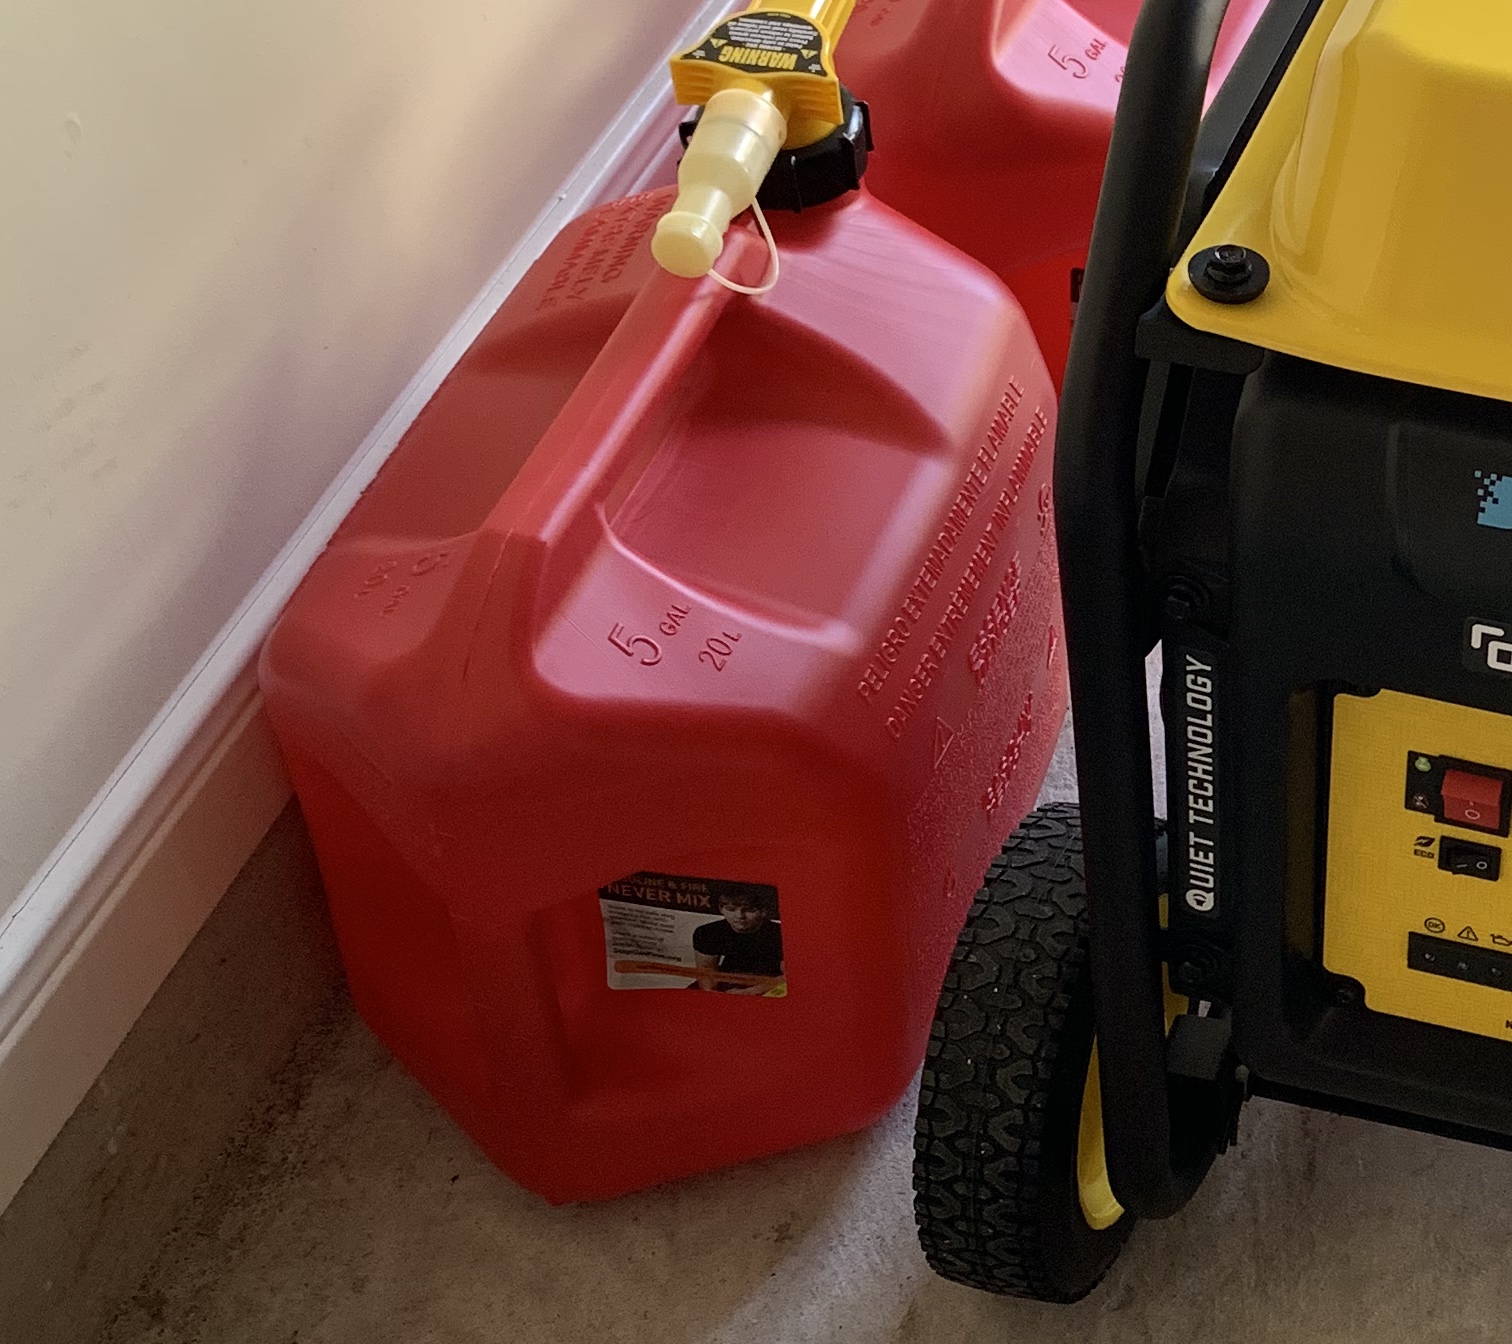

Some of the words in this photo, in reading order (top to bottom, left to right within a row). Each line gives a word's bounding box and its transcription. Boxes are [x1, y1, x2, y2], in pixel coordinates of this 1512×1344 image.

[719, 46, 798, 70] WARNING
[1047, 44, 1090, 79] 5
[607, 622, 663, 666] 5
[659, 604, 692, 636] GAL
[857, 616, 911, 704] PELIGRO
[885, 654, 938, 738] DANGER
[1186, 655, 1214, 824] TECHNOLOGY
[1185, 832, 1214, 911] QUIET
[1414, 849, 1434, 859] ECO
[607, 884, 671, 903] NEVER
[676, 892, 711, 907] MIX
